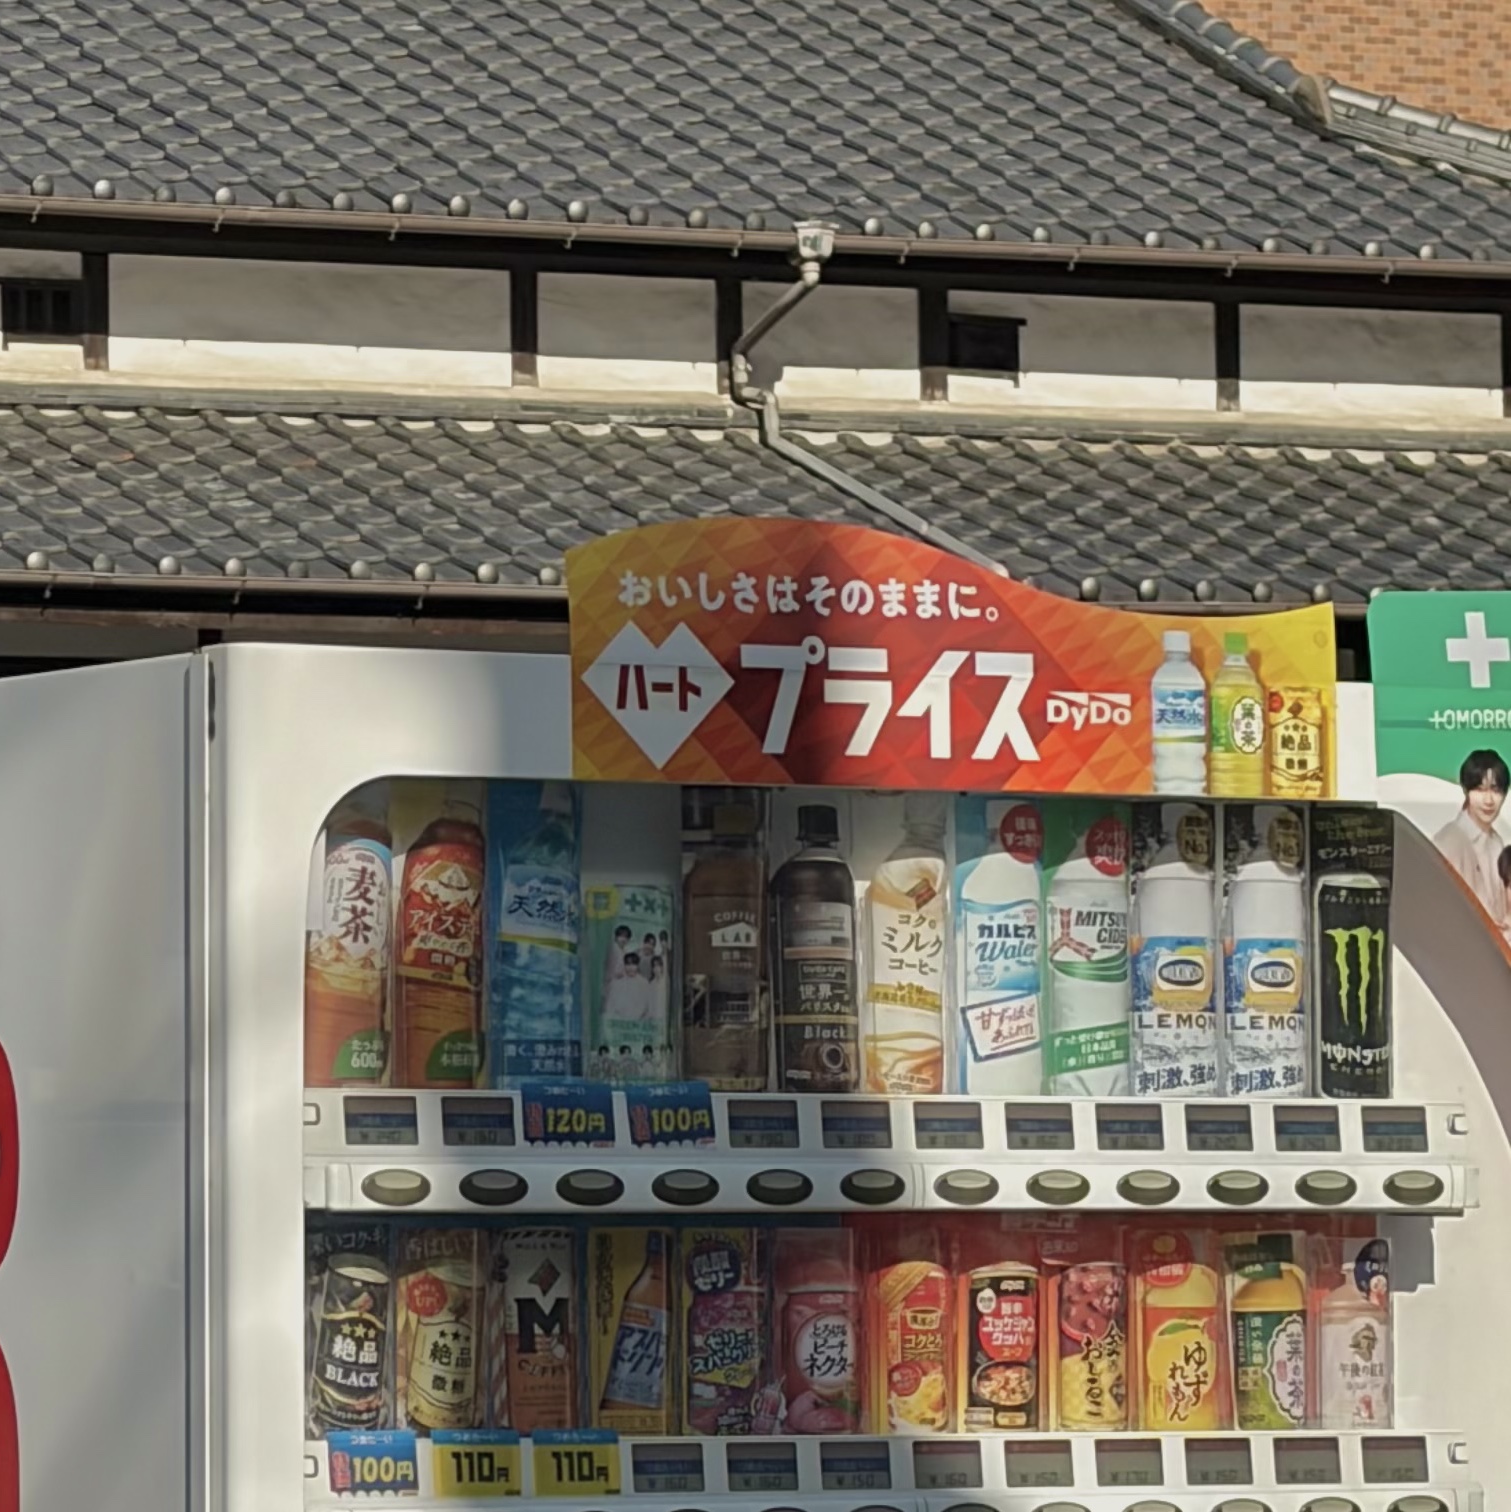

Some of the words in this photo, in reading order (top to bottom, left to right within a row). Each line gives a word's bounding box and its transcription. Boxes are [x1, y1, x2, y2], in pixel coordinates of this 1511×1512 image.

[617, 569, 1001, 624] おいしさはそのままに。
[616, 664, 701, 712] ハート
[741, 635, 1041, 762] プライス
[1046, 690, 1132, 731] DyDo
[339, 866, 377, 944] 麦茶
[881, 926, 943, 958] ミルク
[977, 922, 1036, 939] カルピス
[888, 957, 938, 975] コーヒー
[546, 1107, 606, 1133] 120円
[651, 1107, 711, 1134] 100円
[514, 1297, 570, 1353] M
[332, 1334, 377, 1365] 絶品
[428, 1340, 472, 1368] 絶品
[813, 1340, 848, 1355] ピーチ
[325, 1364, 379, 1387] BLACK
[804, 1355, 854, 1378] ネクター
[1184, 1341, 1209, 1407] ゆず
[1168, 1361, 1190, 1422] れもん
[353, 1456, 415, 1485] 100円
[451, 1450, 511, 1484] 110円
[551, 1450, 609, 1484] 110円
